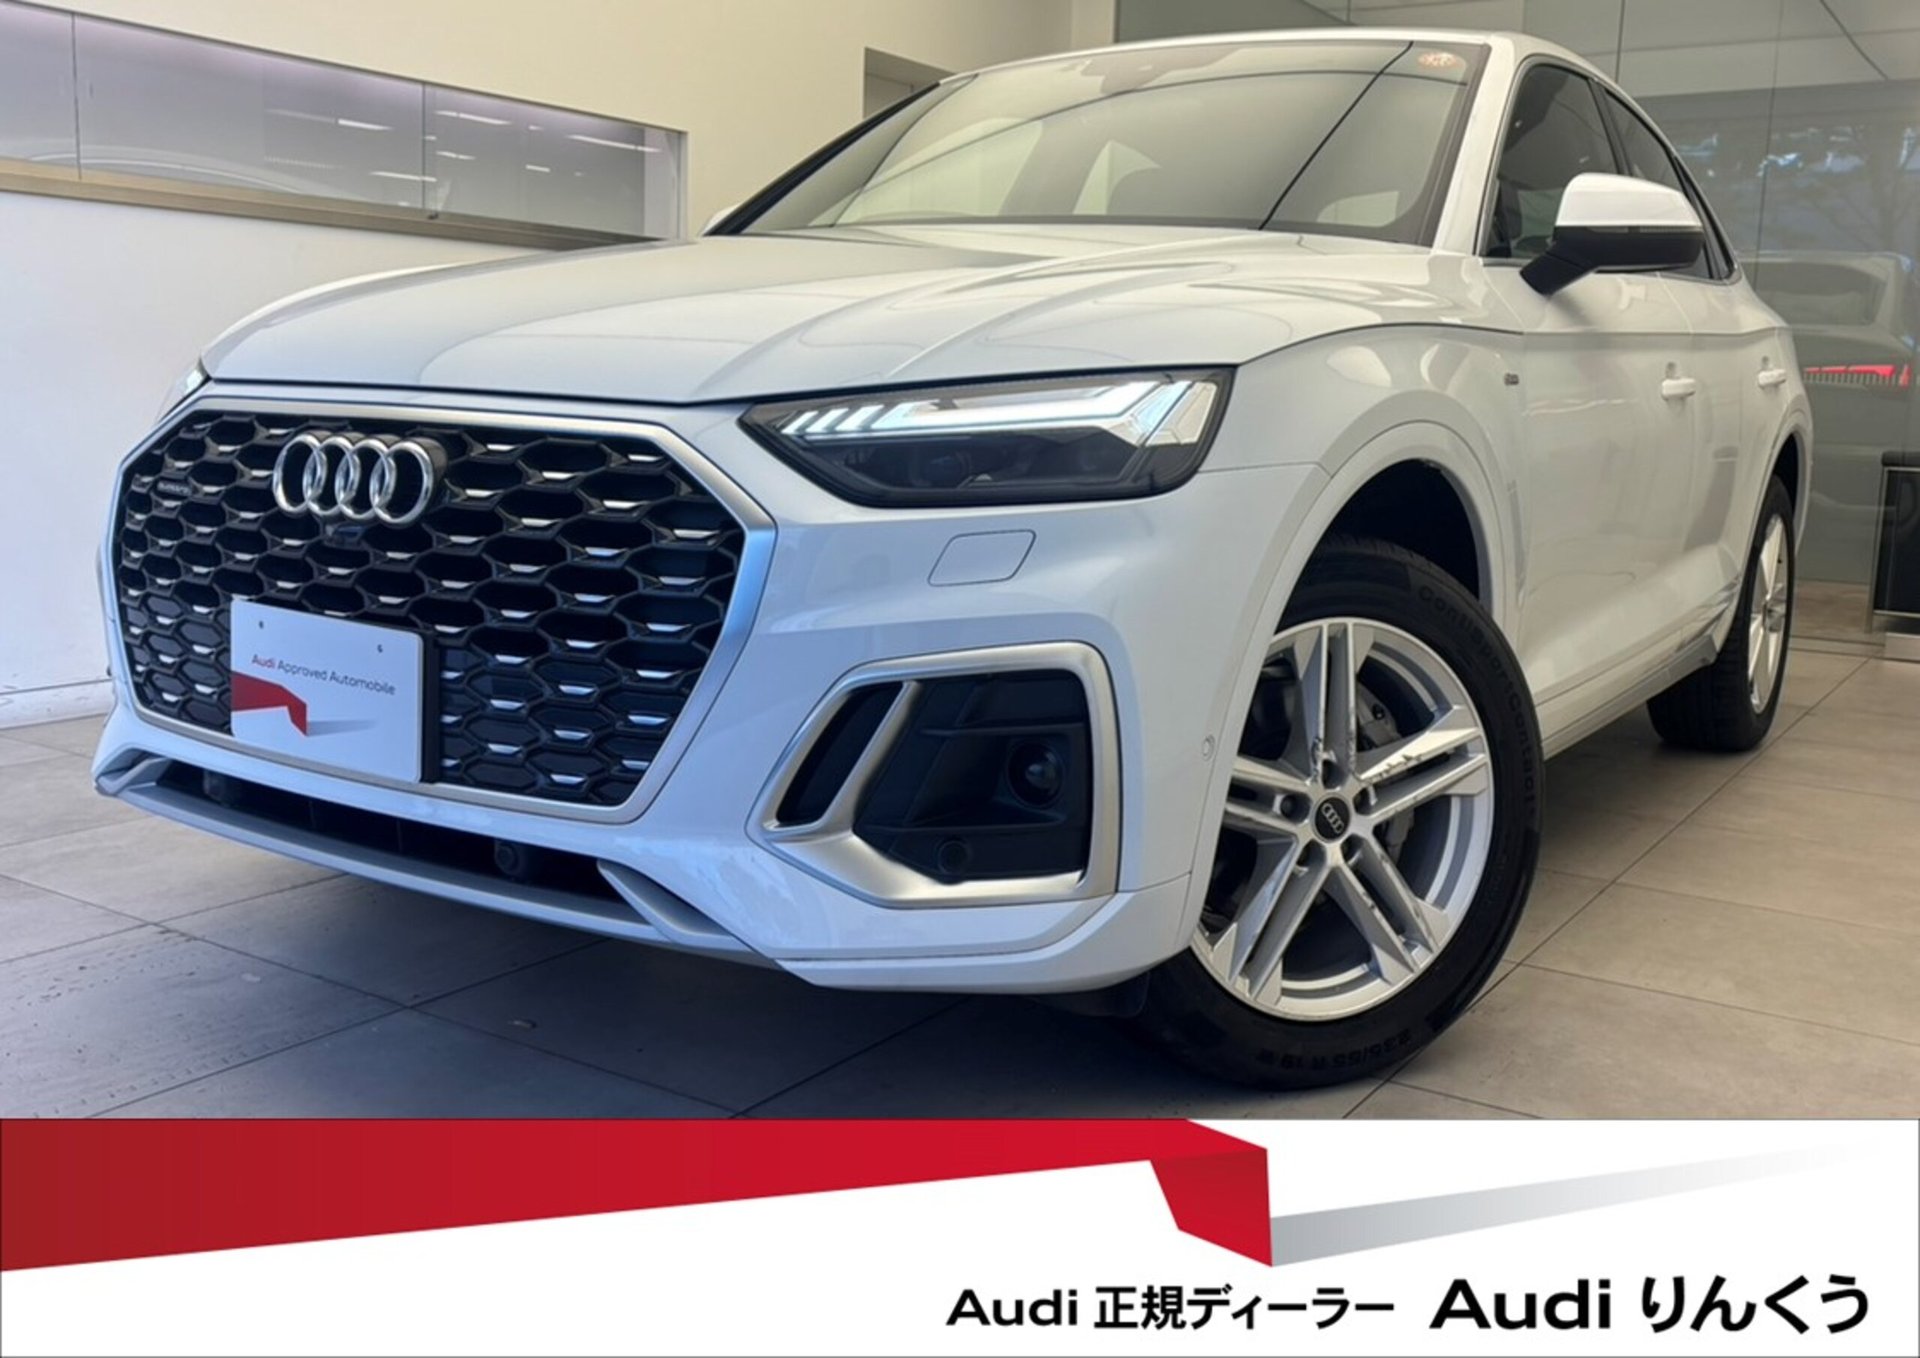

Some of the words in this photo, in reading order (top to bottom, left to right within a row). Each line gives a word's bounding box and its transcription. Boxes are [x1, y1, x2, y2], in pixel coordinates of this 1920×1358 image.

[251, 654, 276, 669] Audi
[277, 660, 328, 681] Approved
[329, 671, 396, 695] Automobile
